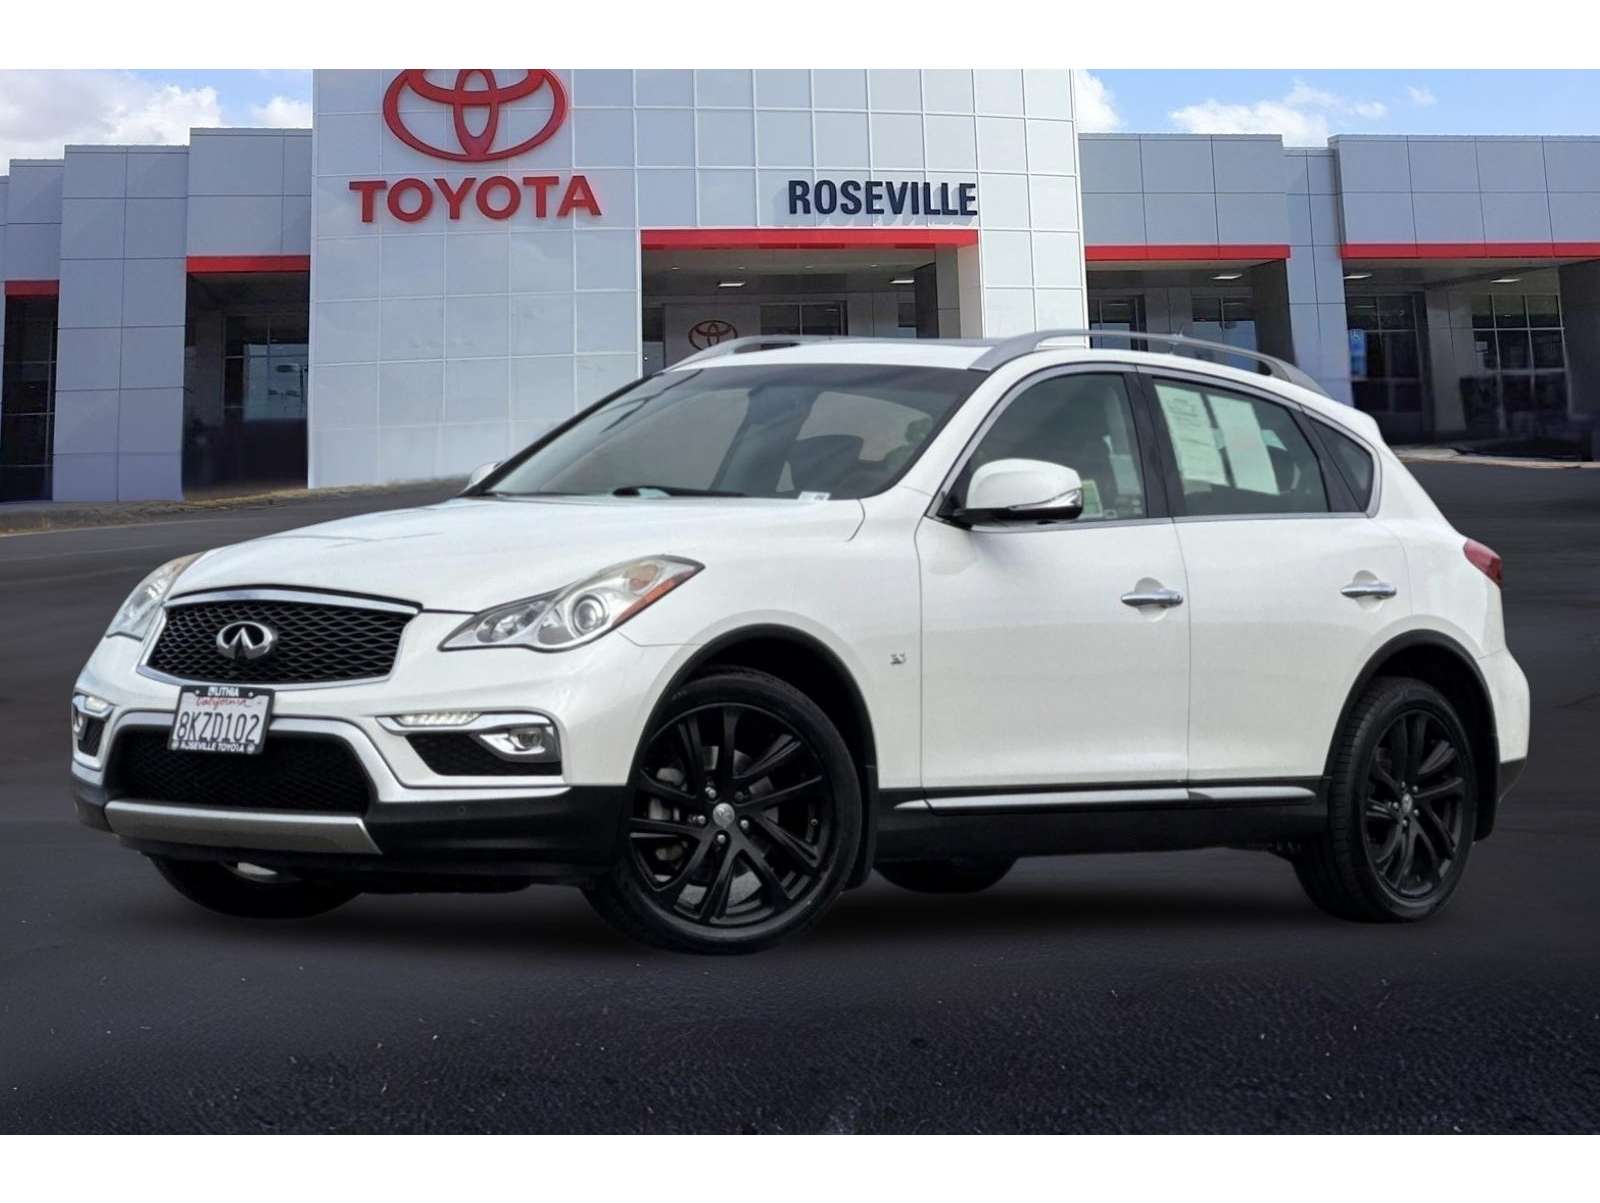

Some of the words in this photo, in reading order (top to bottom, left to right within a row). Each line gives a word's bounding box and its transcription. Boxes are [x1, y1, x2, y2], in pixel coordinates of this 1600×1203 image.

[349, 175, 602, 223] TOYOTA
[789, 180, 978, 216] ROSEVILLE
[176, 711, 260, 744] 8KZD102
[217, 743, 244, 753] TOYOTA
